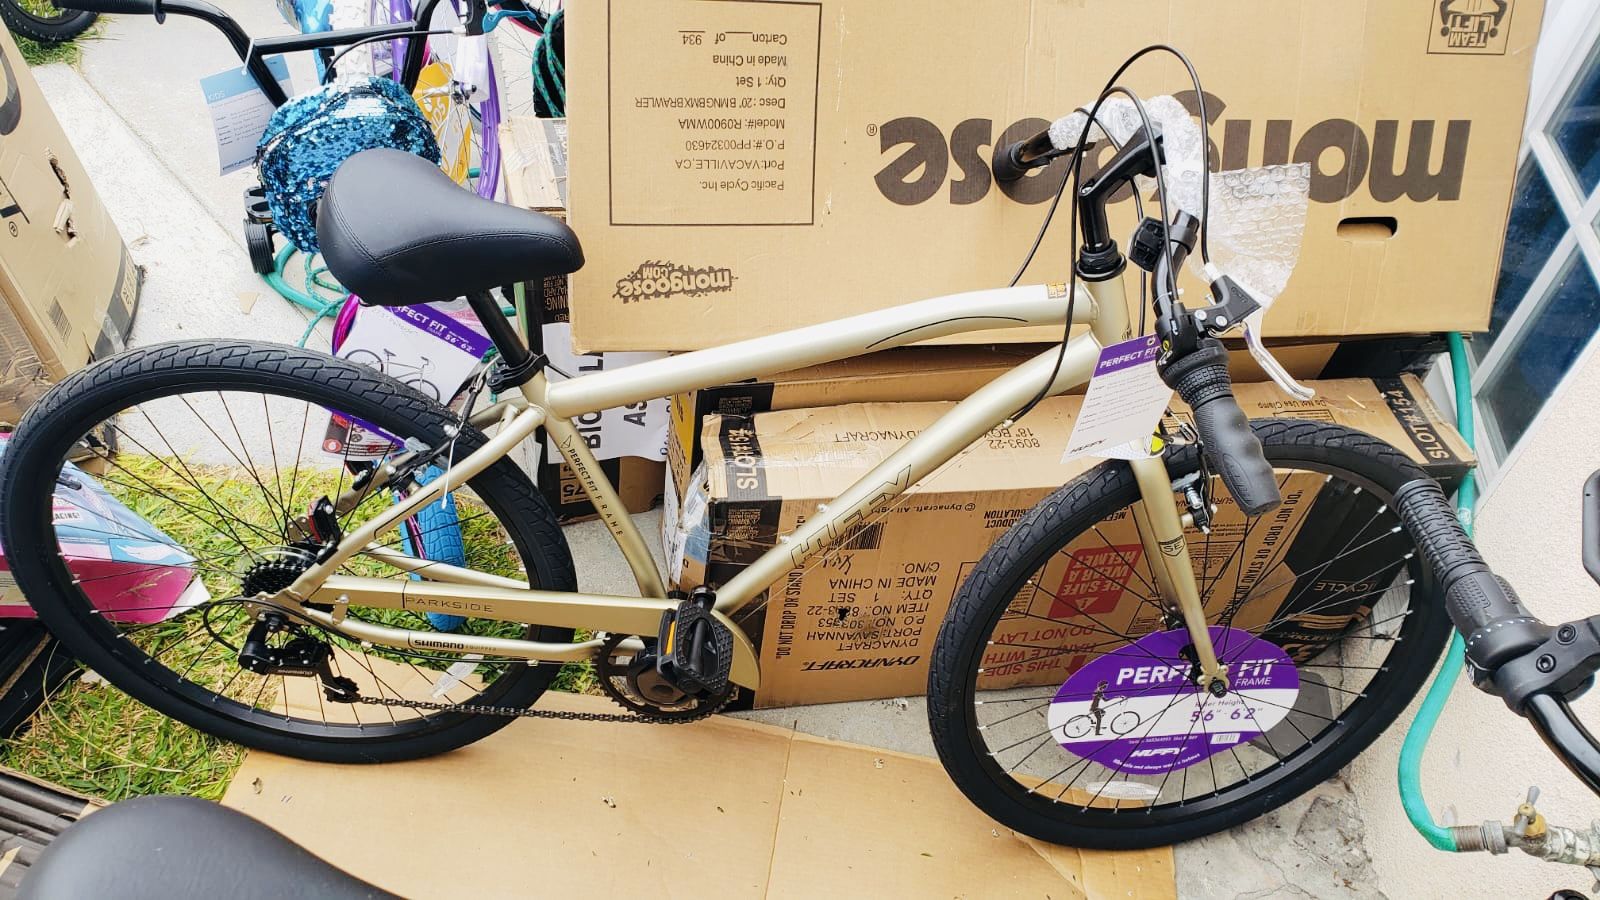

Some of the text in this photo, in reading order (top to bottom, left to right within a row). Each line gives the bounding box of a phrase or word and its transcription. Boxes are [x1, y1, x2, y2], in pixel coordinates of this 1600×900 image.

[1451, 15, 1491, 32] LIFT
[682, 34, 702, 45] 934
[1448, 32, 1488, 48] TEAM
[712, 55, 787, 67] Made in China
[735, 74, 786, 87] Qty: 1 Set
[678, 118, 785, 130] Model#: R0900WMA
[699, 179, 784, 191] Pacific Cycle Inc.
[617, 270, 732, 297] mongoose
[1099, 350, 1142, 369] PERFECT
[1144, 345, 1162, 359] FIT
[1257, 401, 1283, 409] Clamp
[1015, 427, 1033, 438] 18"
[988, 438, 1041, 449] 8093-22
[569, 449, 591, 481] PERFECT
[586, 477, 599, 493] FIT
[54, 511, 81, 520] ACING!
[1275, 502, 1293, 522] NOT
[1263, 522, 1284, 547] DROP
[1074, 550, 1138, 564] HELMET
[1254, 545, 1272, 559] OR
[901, 561, 940, 574] C/NO.
[1068, 564, 1131, 580] WEAR A
[786, 571, 803, 596] STAND
[829, 575, 937, 590] MADE IN CHINA
[1061, 578, 1123, 596] BE SAFE
[1314, 581, 1376, 593] ICYCLE
[784, 594, 800, 609] OR
[828, 589, 933, 603] QTY: 1 SET
[405, 595, 497, 613] PARKSIDE
[897, 602, 930, 613] ITEM
[780, 609, 797, 630] DROP
[779, 630, 795, 646] NOT
[996, 624, 1096, 643] DO NOT LAY
[413, 638, 465, 650] SHIMANO
[836, 638, 919, 651] DYNACRAFT
[800, 655, 921, 672] DYNACRAFT
[984, 651, 1026, 665] WITH
[985, 658, 1062, 677] THIS SIDE
[1239, 658, 1279, 677] FIT
[1234, 676, 1272, 687] FRAME
[1130, 746, 1187, 758] HUFFY
